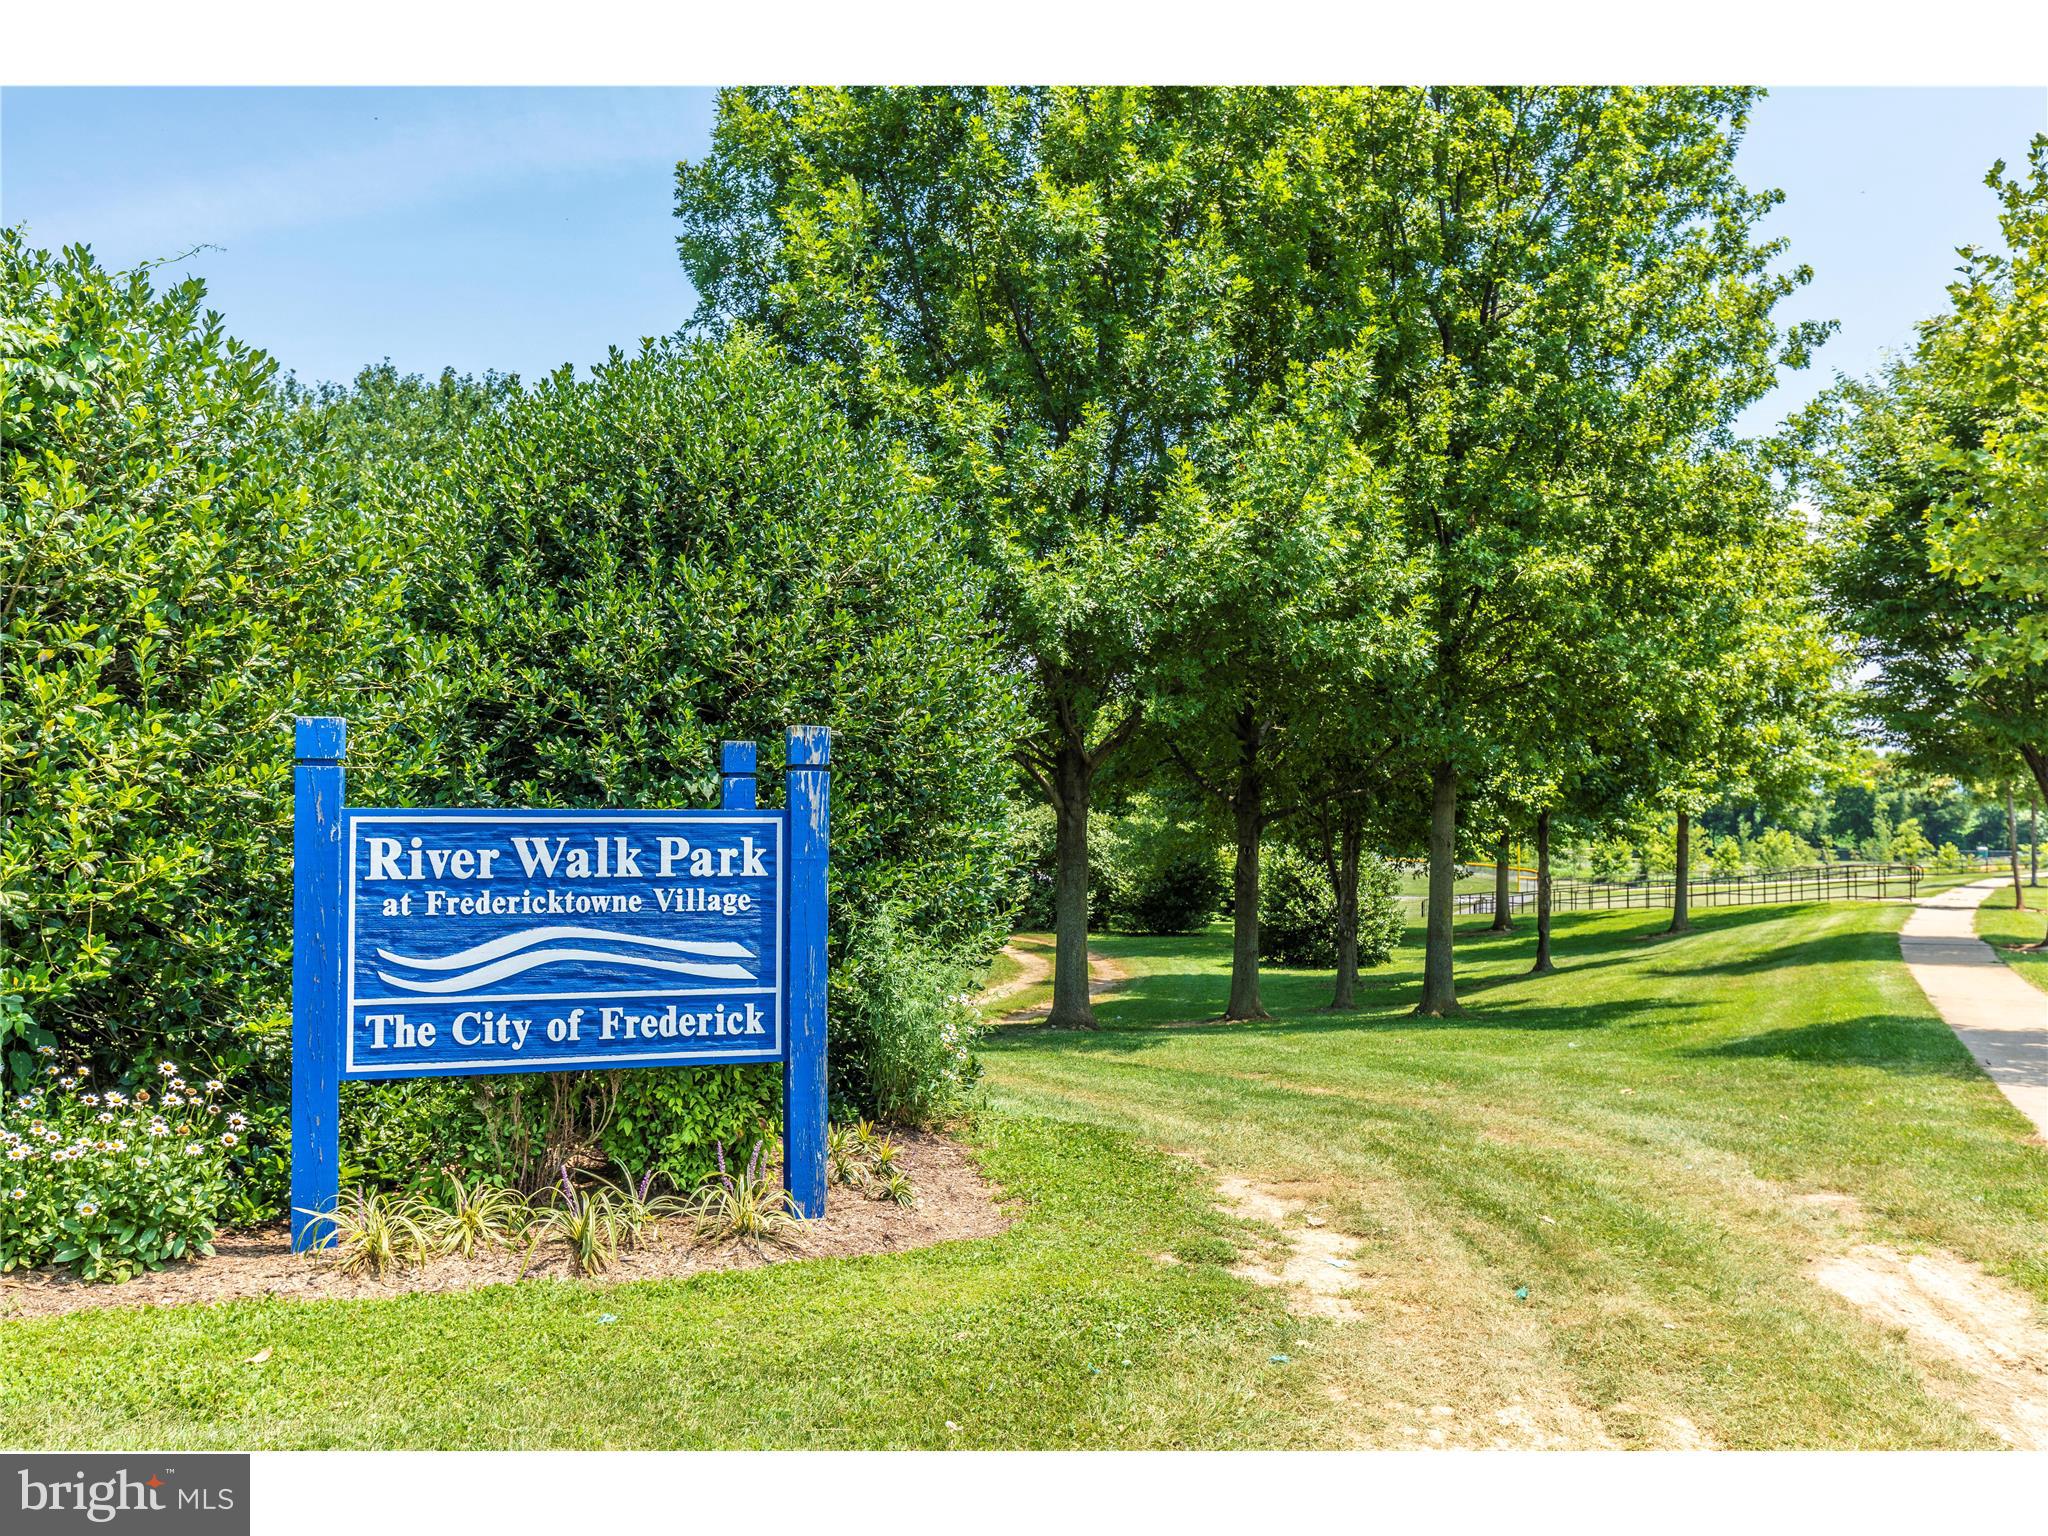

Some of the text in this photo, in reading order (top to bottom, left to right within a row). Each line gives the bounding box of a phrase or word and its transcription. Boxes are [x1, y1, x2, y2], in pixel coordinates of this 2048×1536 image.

[364, 836, 769, 881] River Walk Park
[382, 887, 752, 917] at Fredericktowne Village
[364, 1002, 767, 1051] The City of Frederick
